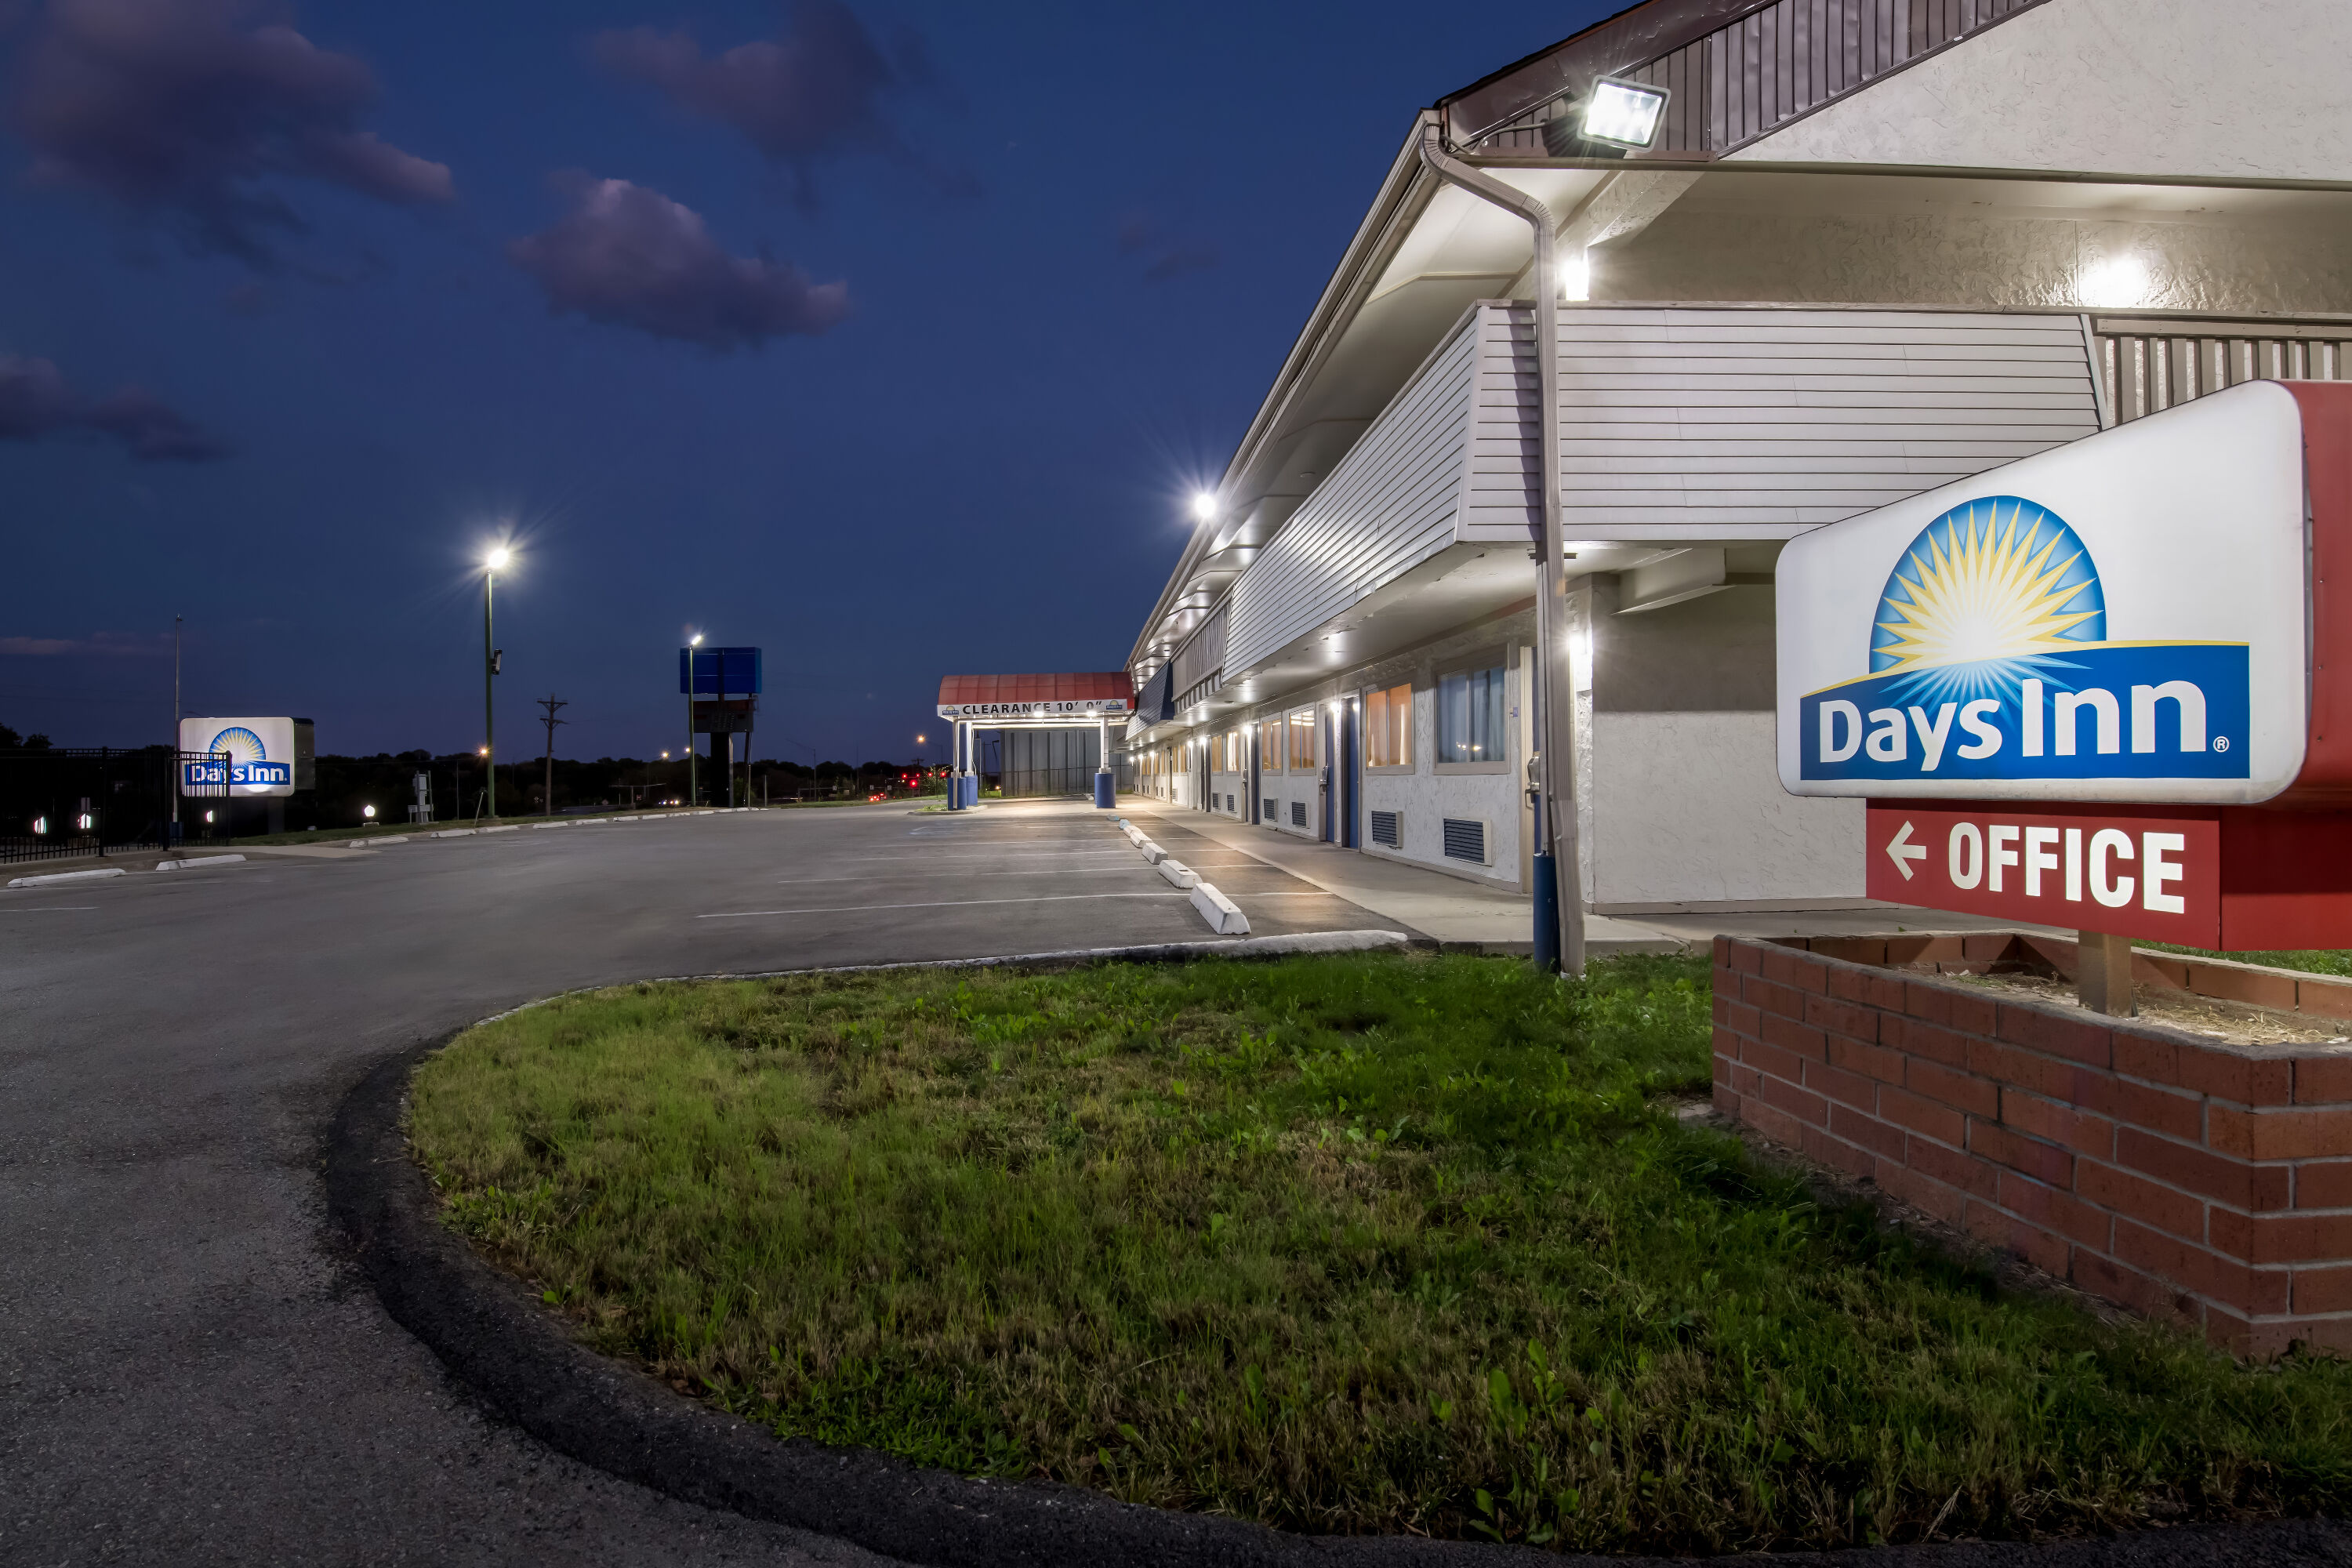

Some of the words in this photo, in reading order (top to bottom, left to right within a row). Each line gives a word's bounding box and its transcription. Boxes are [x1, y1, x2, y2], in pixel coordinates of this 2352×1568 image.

[962, 702, 1051, 715] CLEARANCE
[1819, 698, 2003, 771] Days
[2022, 678, 2207, 757] Inn
[1948, 822, 2186, 914] OFFICE
